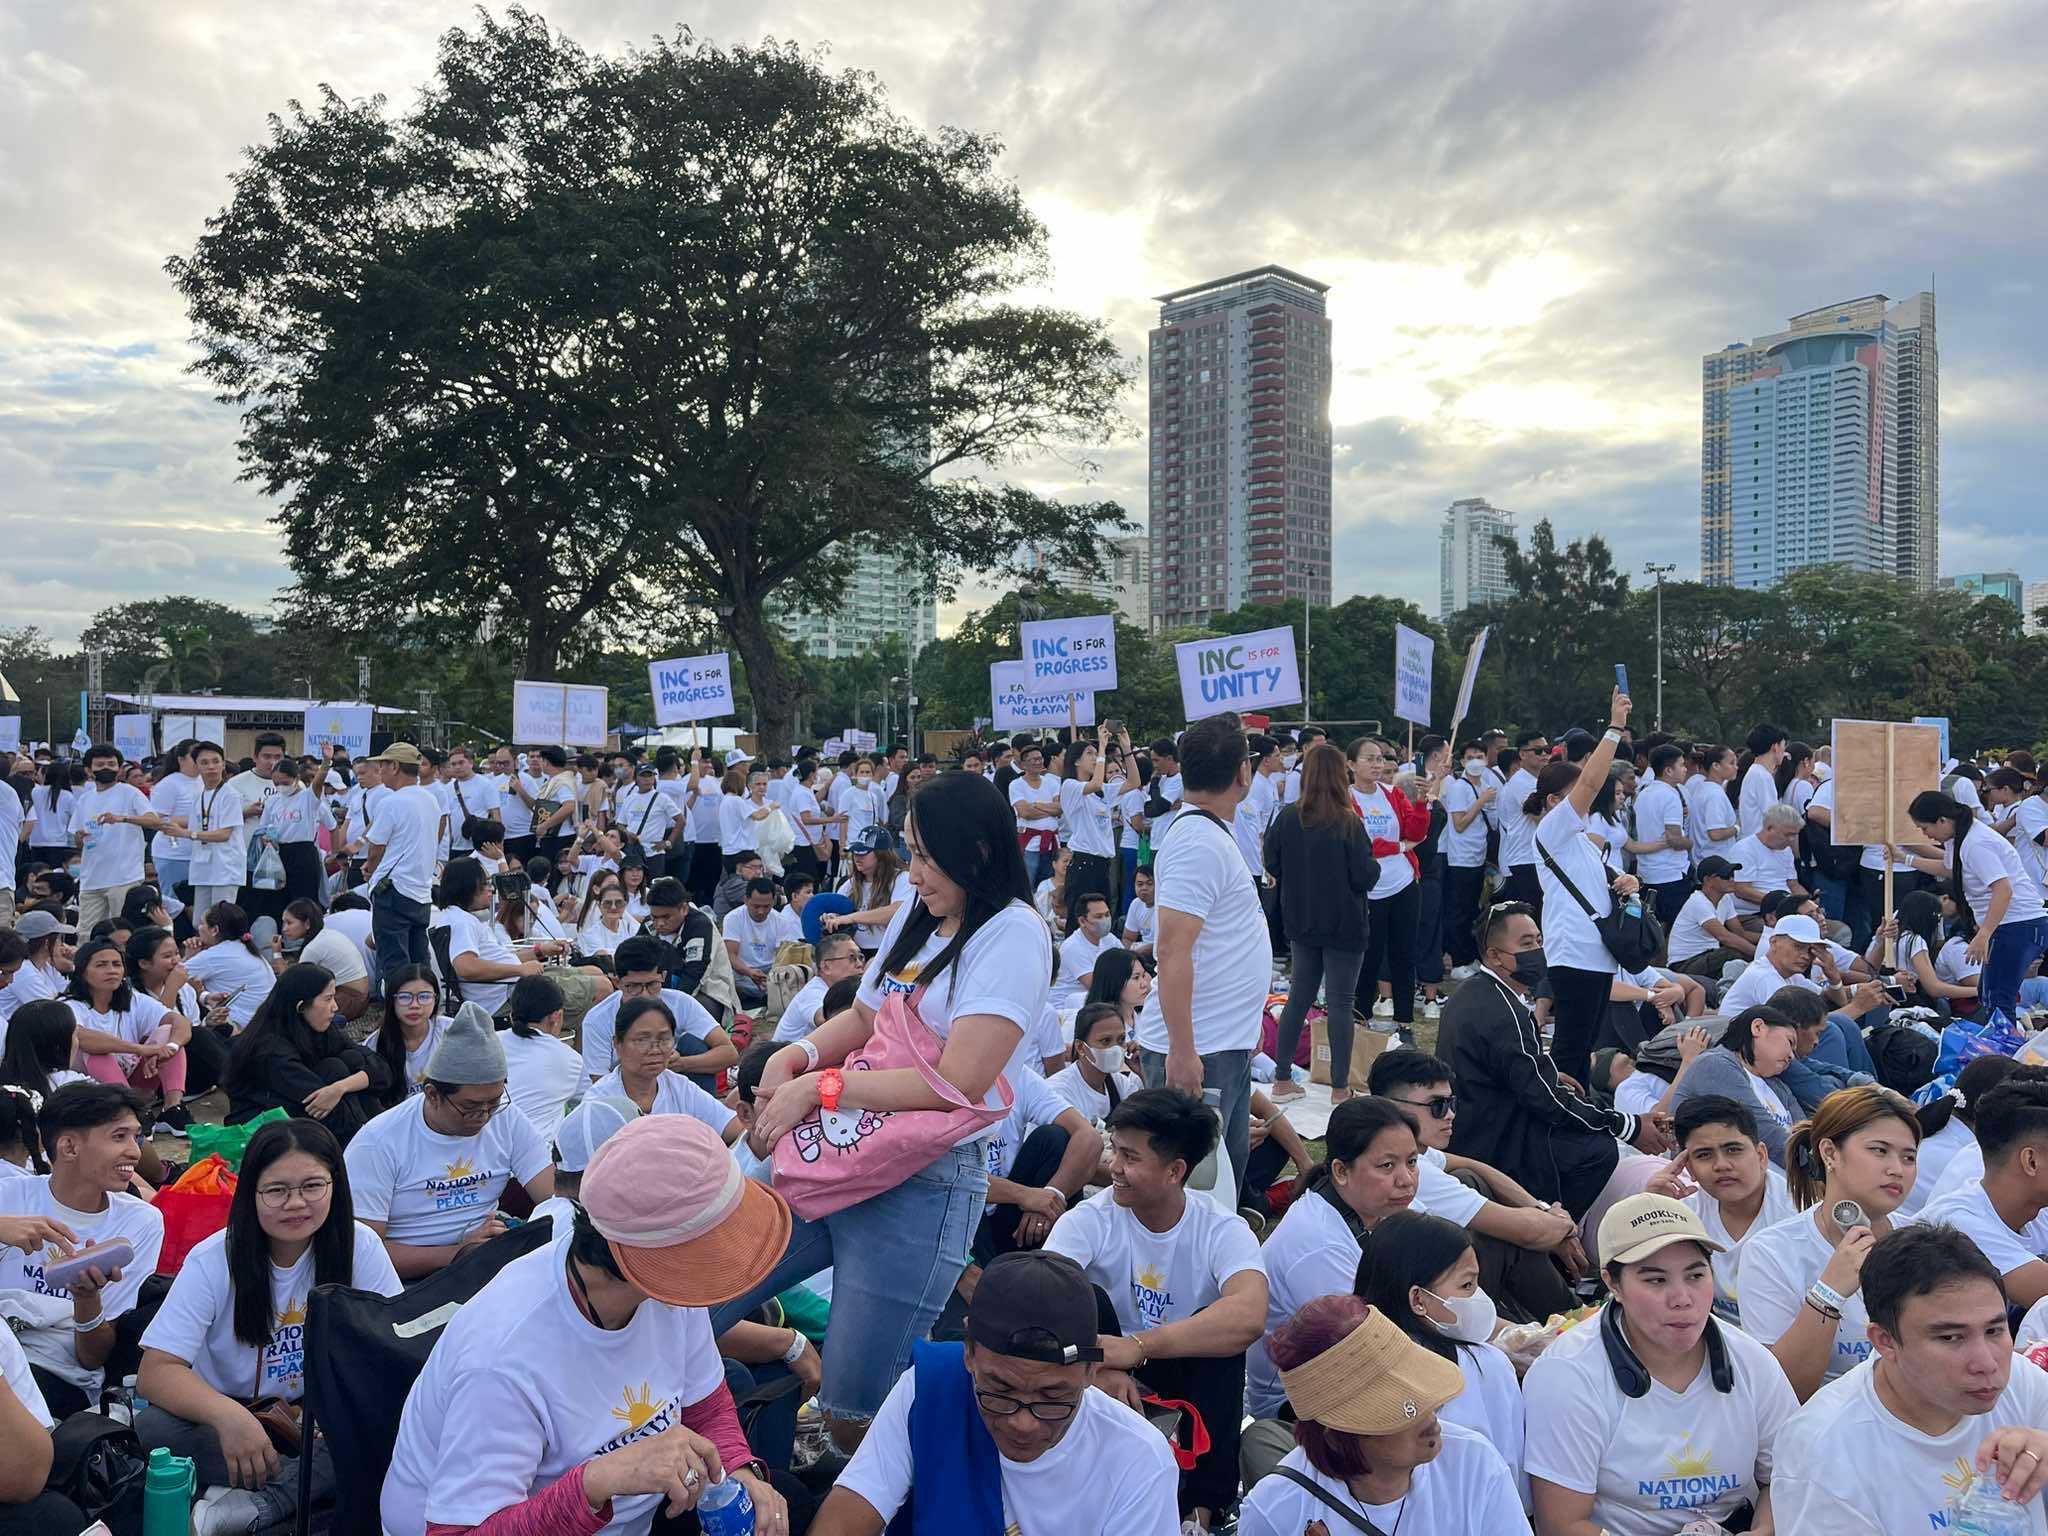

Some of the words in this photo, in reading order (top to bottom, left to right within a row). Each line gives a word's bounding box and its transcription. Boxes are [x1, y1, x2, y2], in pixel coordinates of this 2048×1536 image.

[1031, 637, 1068, 659] INC
[1073, 641, 1082, 651] IS
[1086, 639, 1106, 650] FOR
[1035, 656, 1108, 677] PROGRESS
[1198, 645, 1245, 676] INC
[1248, 651, 1258, 661] IS
[1260, 647, 1280, 660] FOR
[660, 668, 689, 690] INC
[694, 671, 702, 681] IS
[705, 668, 722, 680] FOR
[1201, 666, 1282, 703] UNITY
[662, 684, 726, 706] PROGRESS
[1012, 705, 1028, 716] NG
[437, 1192, 480, 1209] PEACE
[1630, 1210, 1688, 1228] BROOKLYN
[1638, 1474, 1741, 1496] NATIONAL
